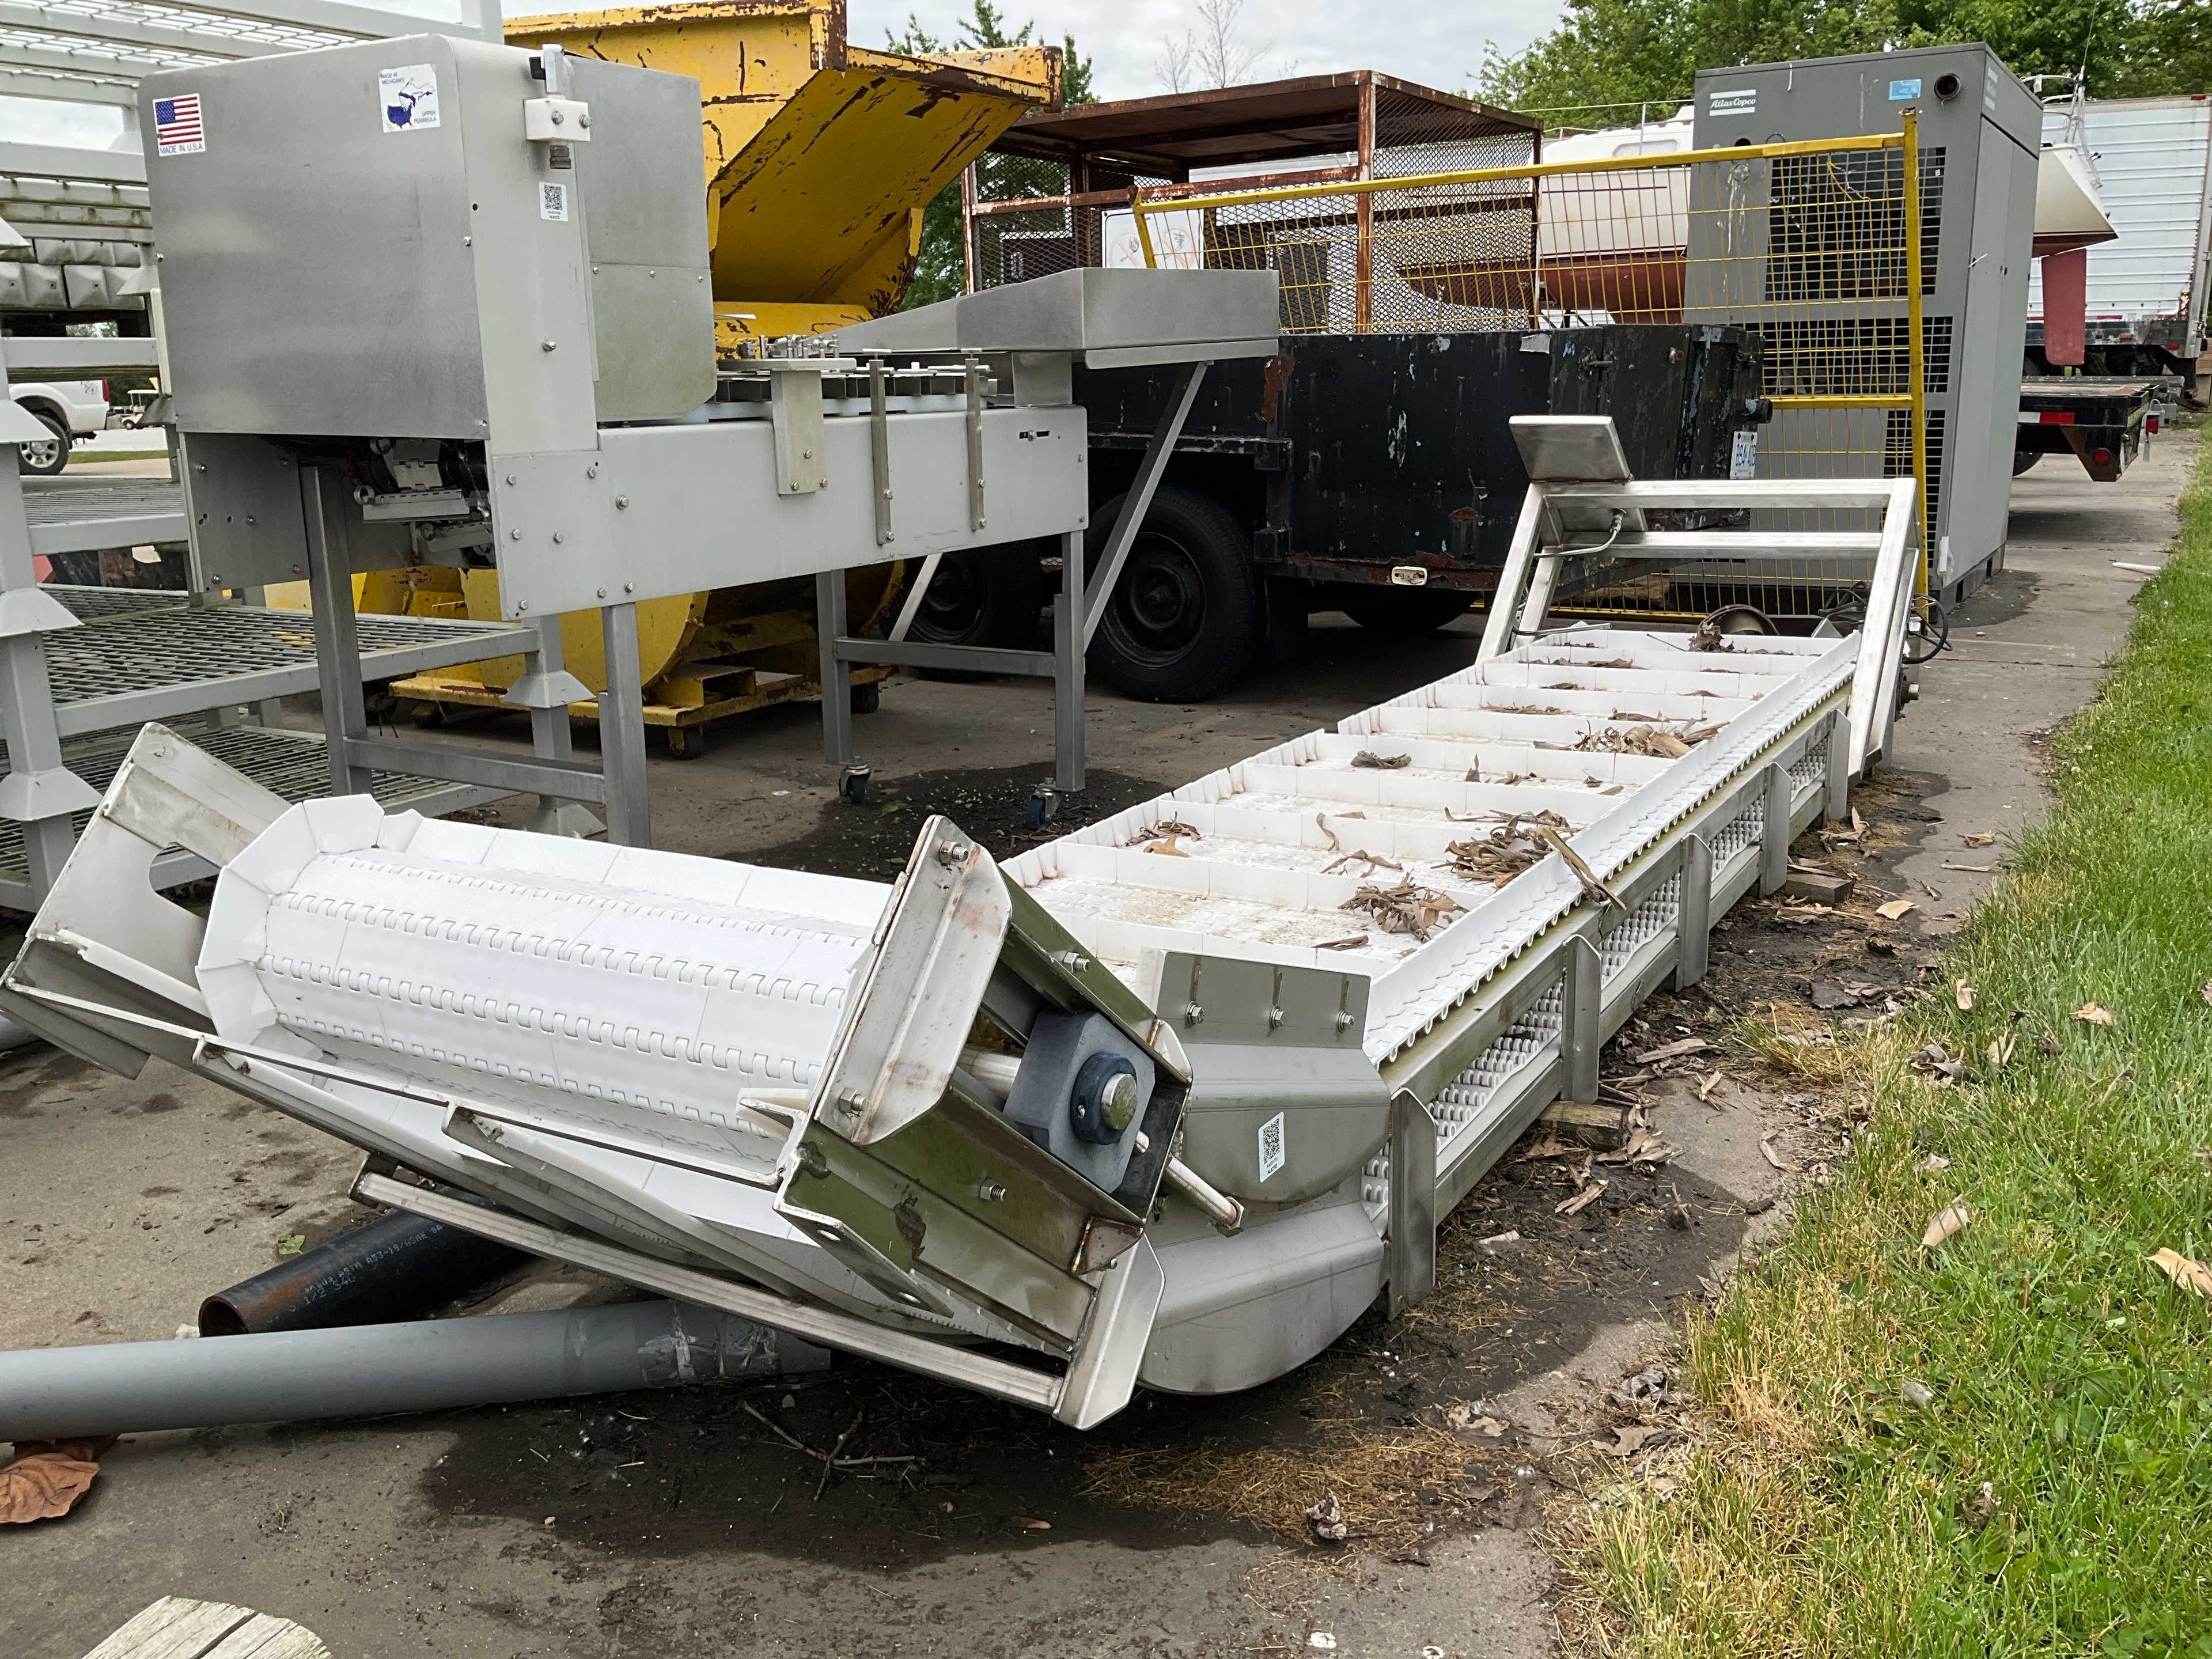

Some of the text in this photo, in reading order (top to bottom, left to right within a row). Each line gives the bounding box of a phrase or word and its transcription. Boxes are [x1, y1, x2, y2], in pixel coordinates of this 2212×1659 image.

[1710, 98, 1756, 109] Atlas Copco
[160, 145, 176, 154] MADE
[179, 144, 185, 152] IN
[338, 1261, 363, 1278] ASTM
